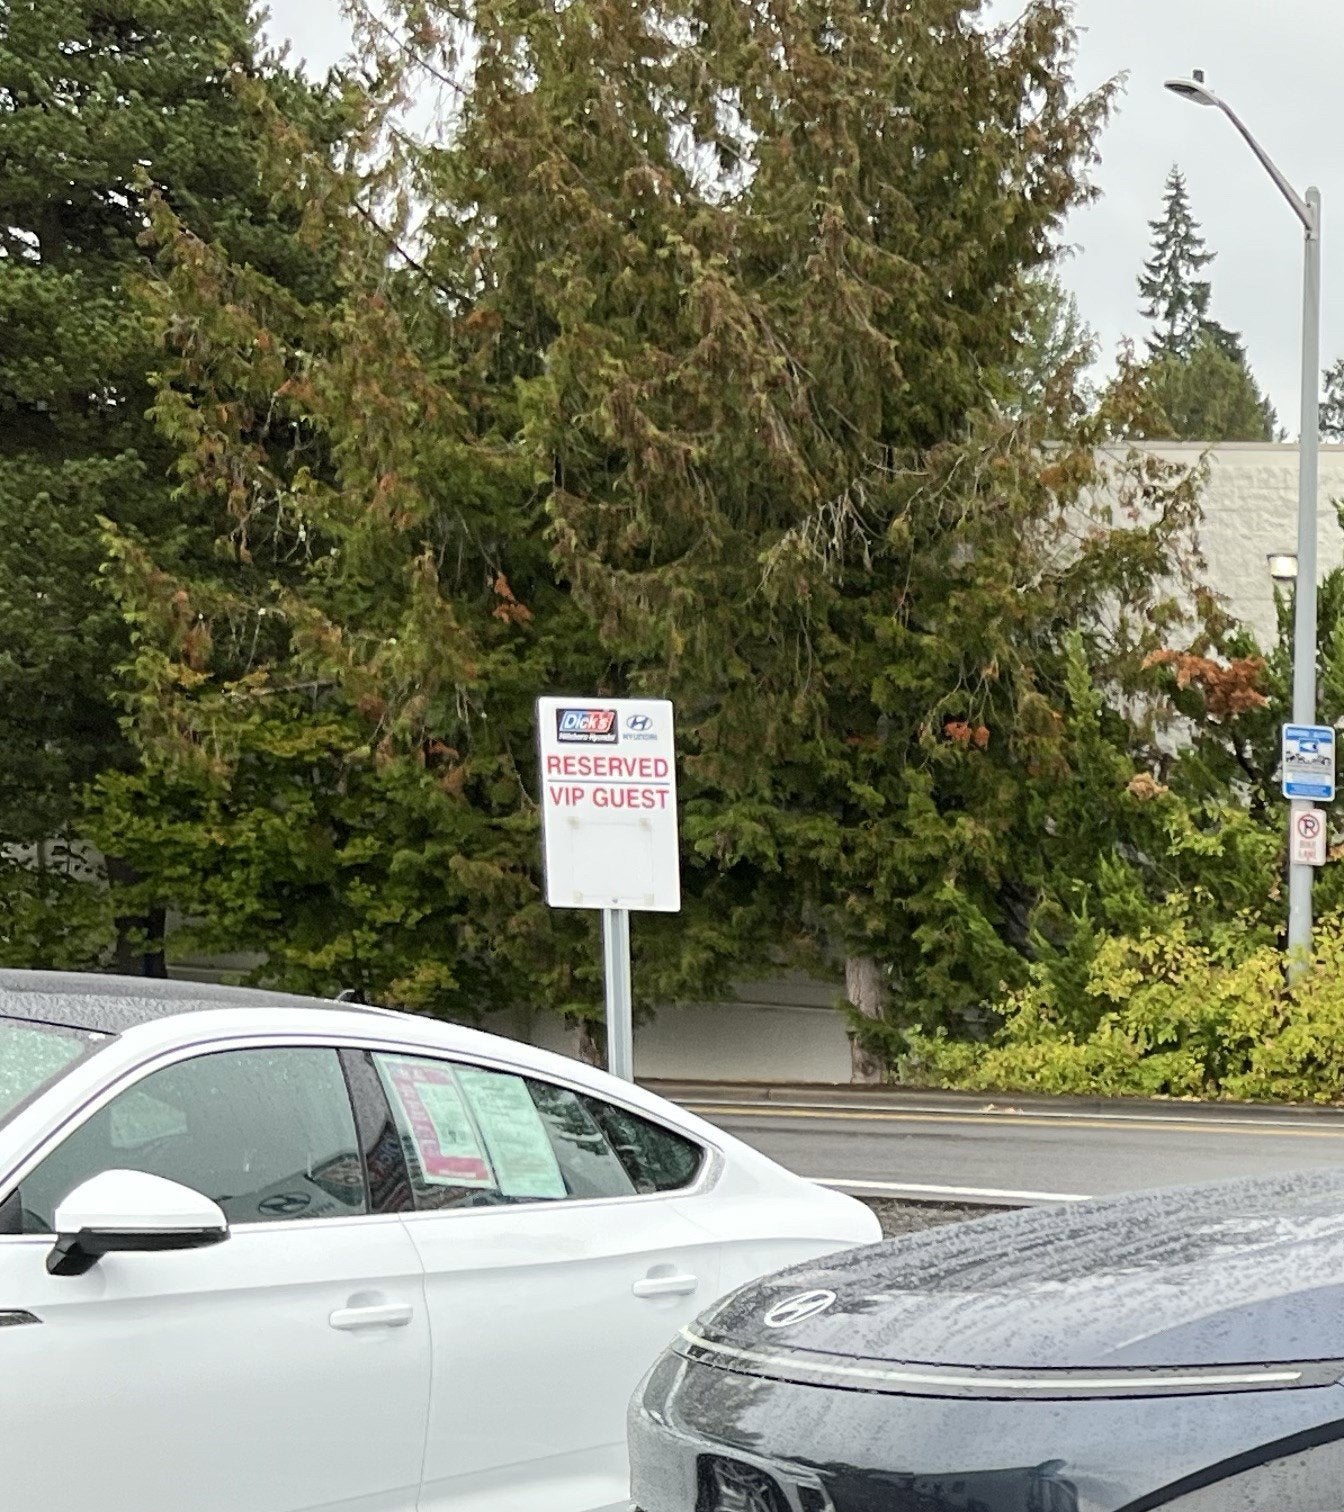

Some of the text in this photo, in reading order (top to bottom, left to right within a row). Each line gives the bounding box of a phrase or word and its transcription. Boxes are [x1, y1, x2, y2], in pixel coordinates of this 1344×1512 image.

[547, 755, 668, 778] RESERVED
[549, 787, 669, 809] VIP GUEST
